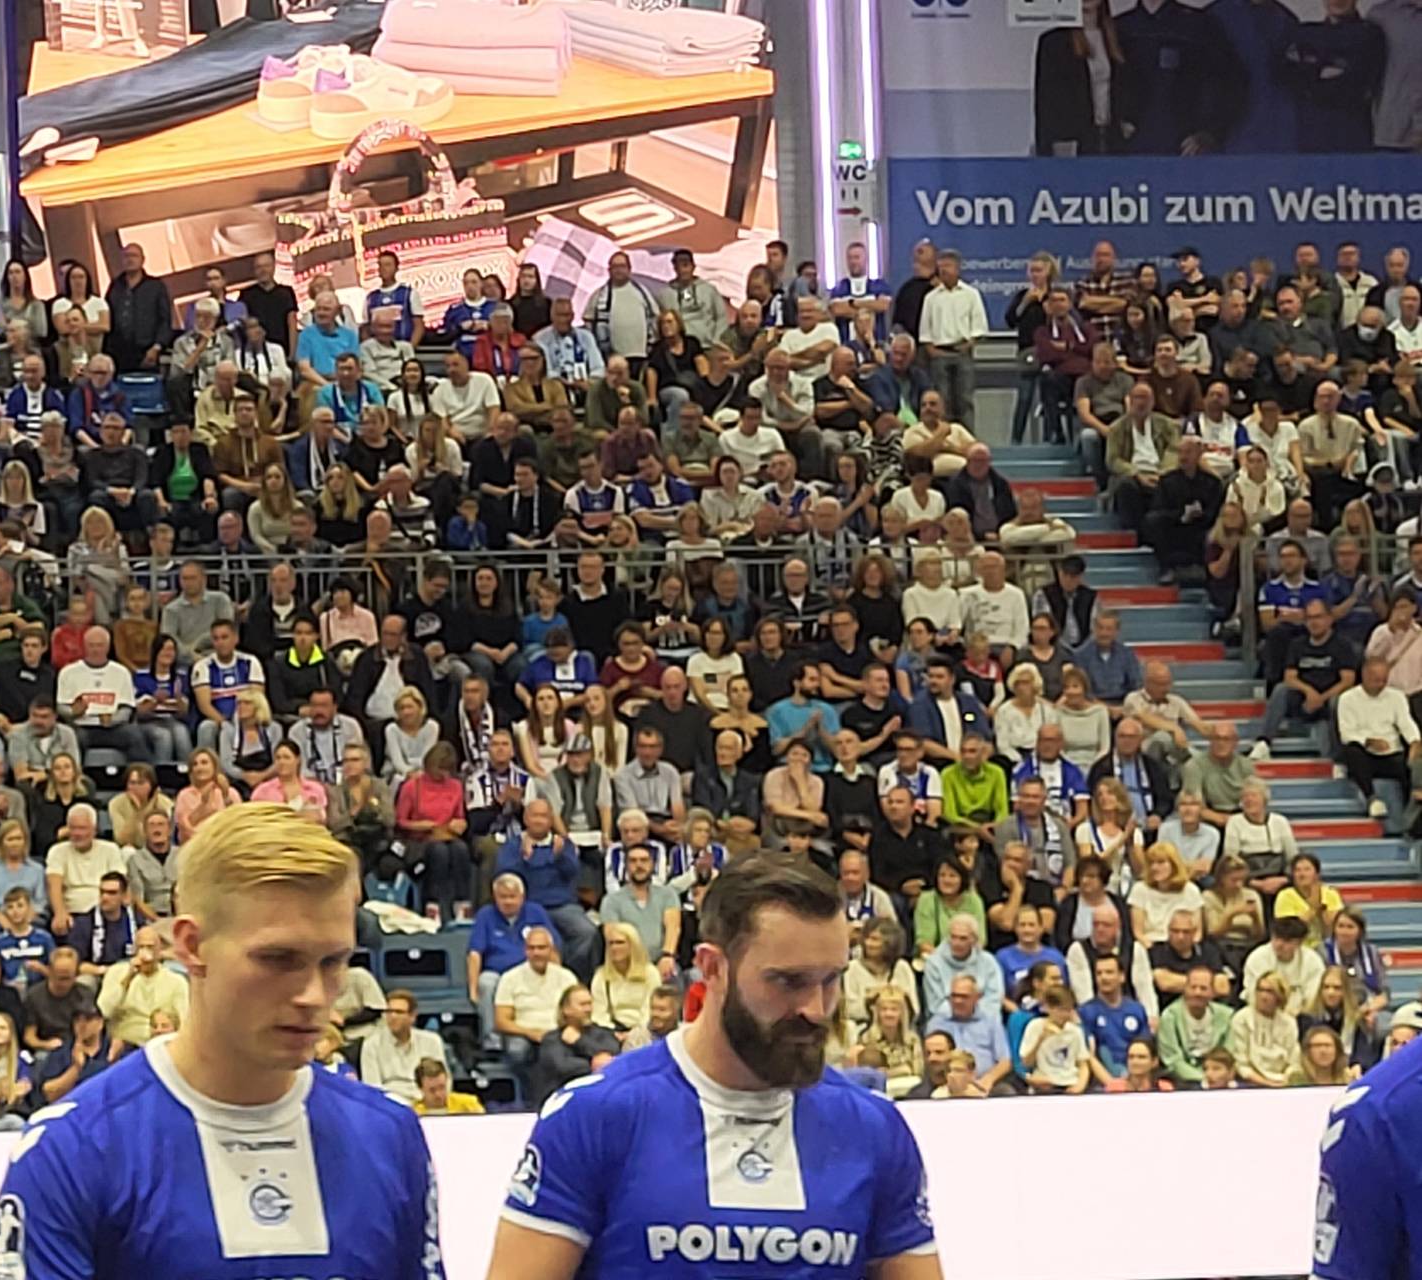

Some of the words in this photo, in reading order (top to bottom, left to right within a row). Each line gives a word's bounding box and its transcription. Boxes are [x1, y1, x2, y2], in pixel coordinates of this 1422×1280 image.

[834, 165, 867, 181] WC
[915, 190, 1015, 225] Vom
[1029, 184, 1149, 225] Azubi
[1164, 195, 1255, 223] zum
[1269, 185, 1422, 223] Weltma
[647, 1223, 858, 1266] POLYGON
